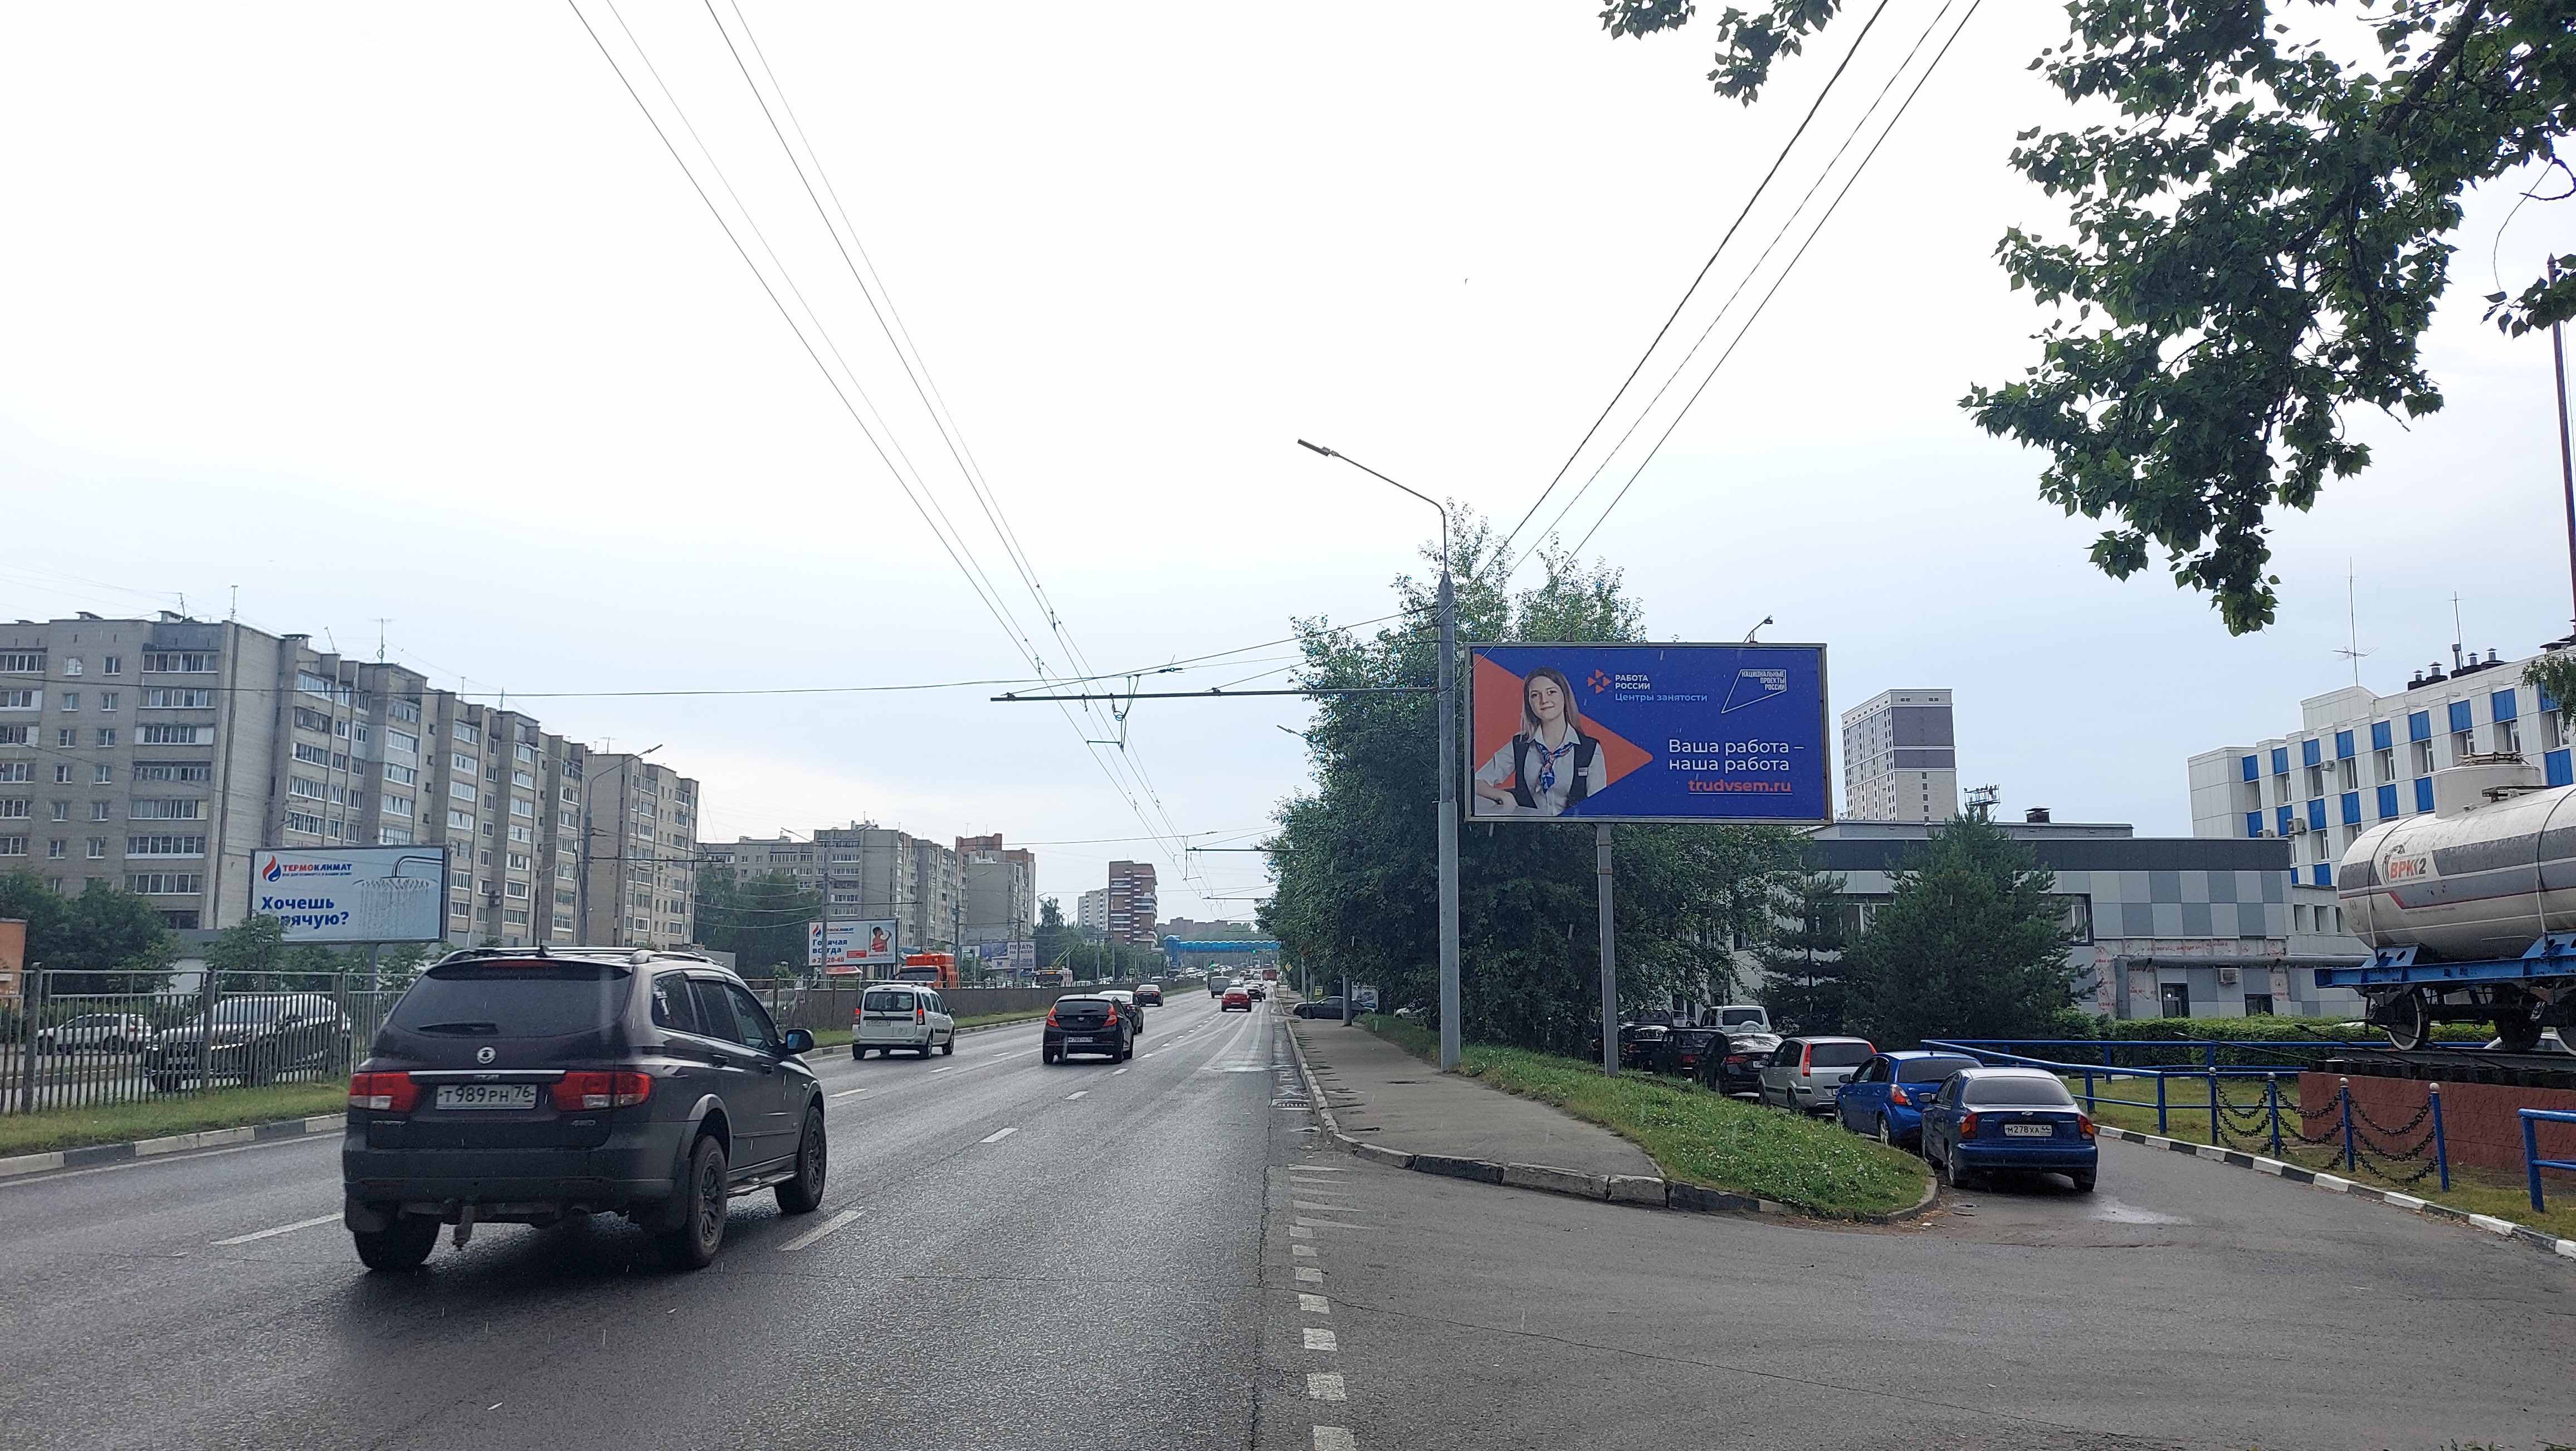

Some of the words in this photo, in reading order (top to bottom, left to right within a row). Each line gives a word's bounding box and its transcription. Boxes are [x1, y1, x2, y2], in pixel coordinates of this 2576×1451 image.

[1615, 693, 1654, 702] Центры
[1669, 739, 1719, 753] Ваша
[1725, 739, 1789, 756] работа
[1669, 758, 1718, 770] наша
[1725, 757, 1789, 773] работа
[1688, 778, 1792, 792] trudvsem.ru
[261, 896, 334, 910] Хочешь
[280, 912, 349, 929] рячую?
[444, 1087, 509, 1103] Т989РН
[514, 1086, 530, 1098] 76
